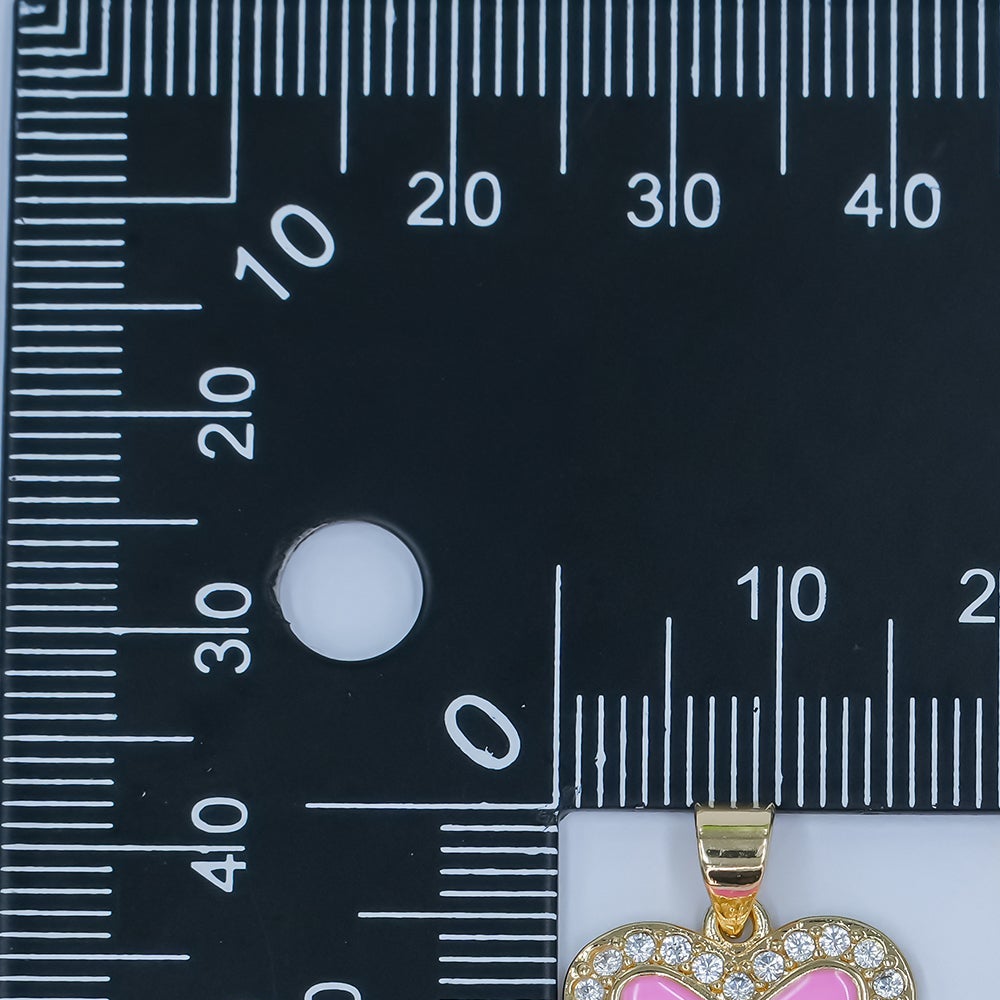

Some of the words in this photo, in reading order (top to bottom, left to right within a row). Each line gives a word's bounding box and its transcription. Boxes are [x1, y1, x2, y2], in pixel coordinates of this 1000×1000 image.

[407, 171, 501, 228] 20
[627, 173, 720, 228] 30
[844, 173, 940, 228] 40
[235, 204, 335, 301] 10
[198, 366, 256, 460] 20
[194, 582, 252, 674] 30
[738, 566, 826, 621] 10
[444, 695, 520, 770] 0
[191, 797, 248, 892] 40
